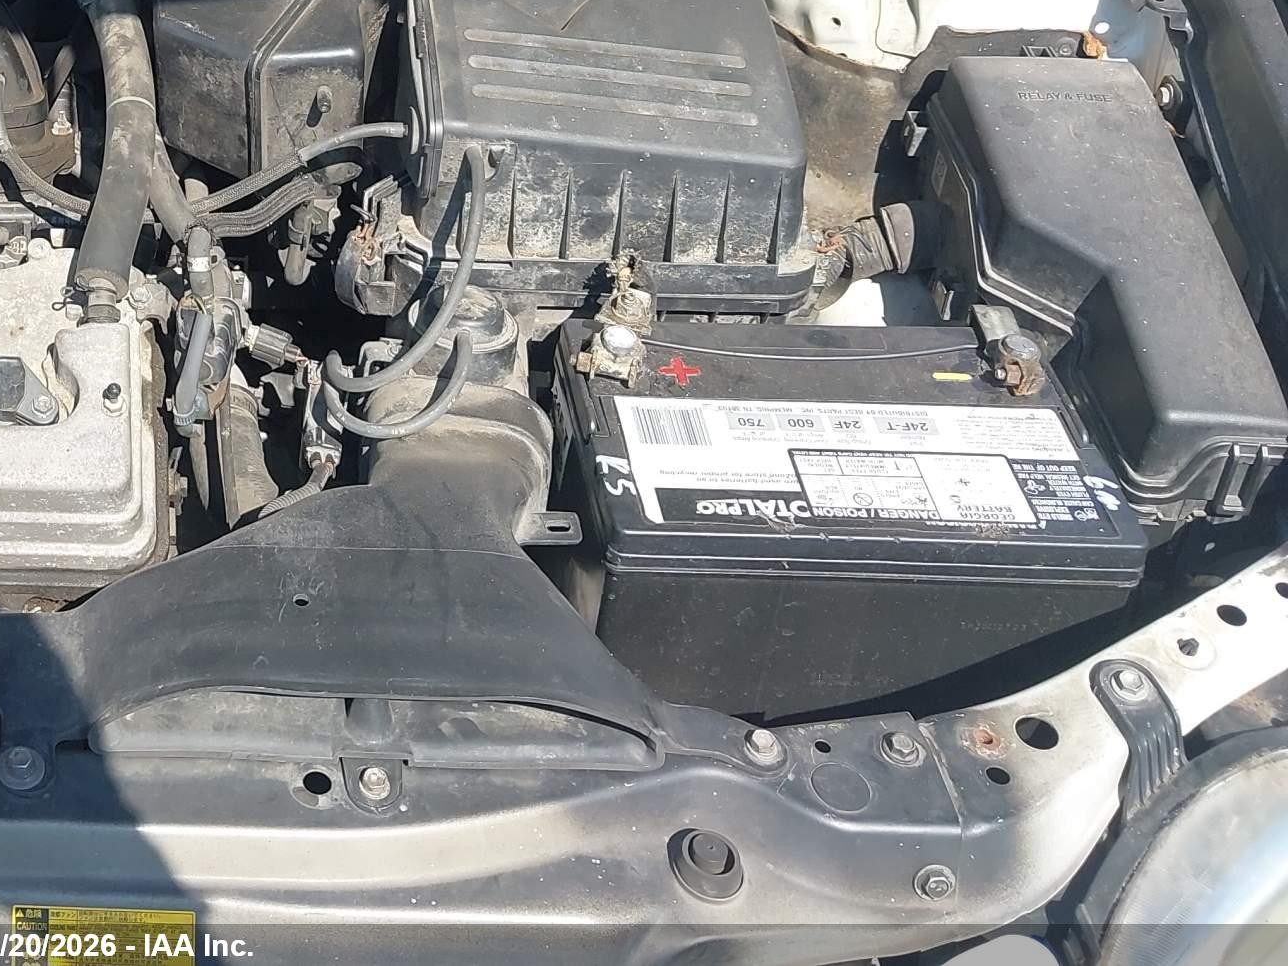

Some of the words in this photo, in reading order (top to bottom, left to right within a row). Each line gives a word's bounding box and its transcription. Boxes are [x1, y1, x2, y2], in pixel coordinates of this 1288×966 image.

[1017, 91, 1060, 101] RELAY
[1064, 92, 1072, 100] &
[1075, 92, 1113, 103] FUSE
[738, 417, 765, 427] 750
[788, 418, 814, 428] 600
[833, 420, 862, 429] 24F
[887, 421, 929, 432] 24F-T
[696, 498, 810, 518] OTALPRO
[813, 507, 870, 518] POISON
[956, 505, 1013, 514] BATTERY
[875, 508, 940, 520] DANGER
[960, 512, 1015, 521] GEORGIA
[16, 921, 48, 932] CAUTION
